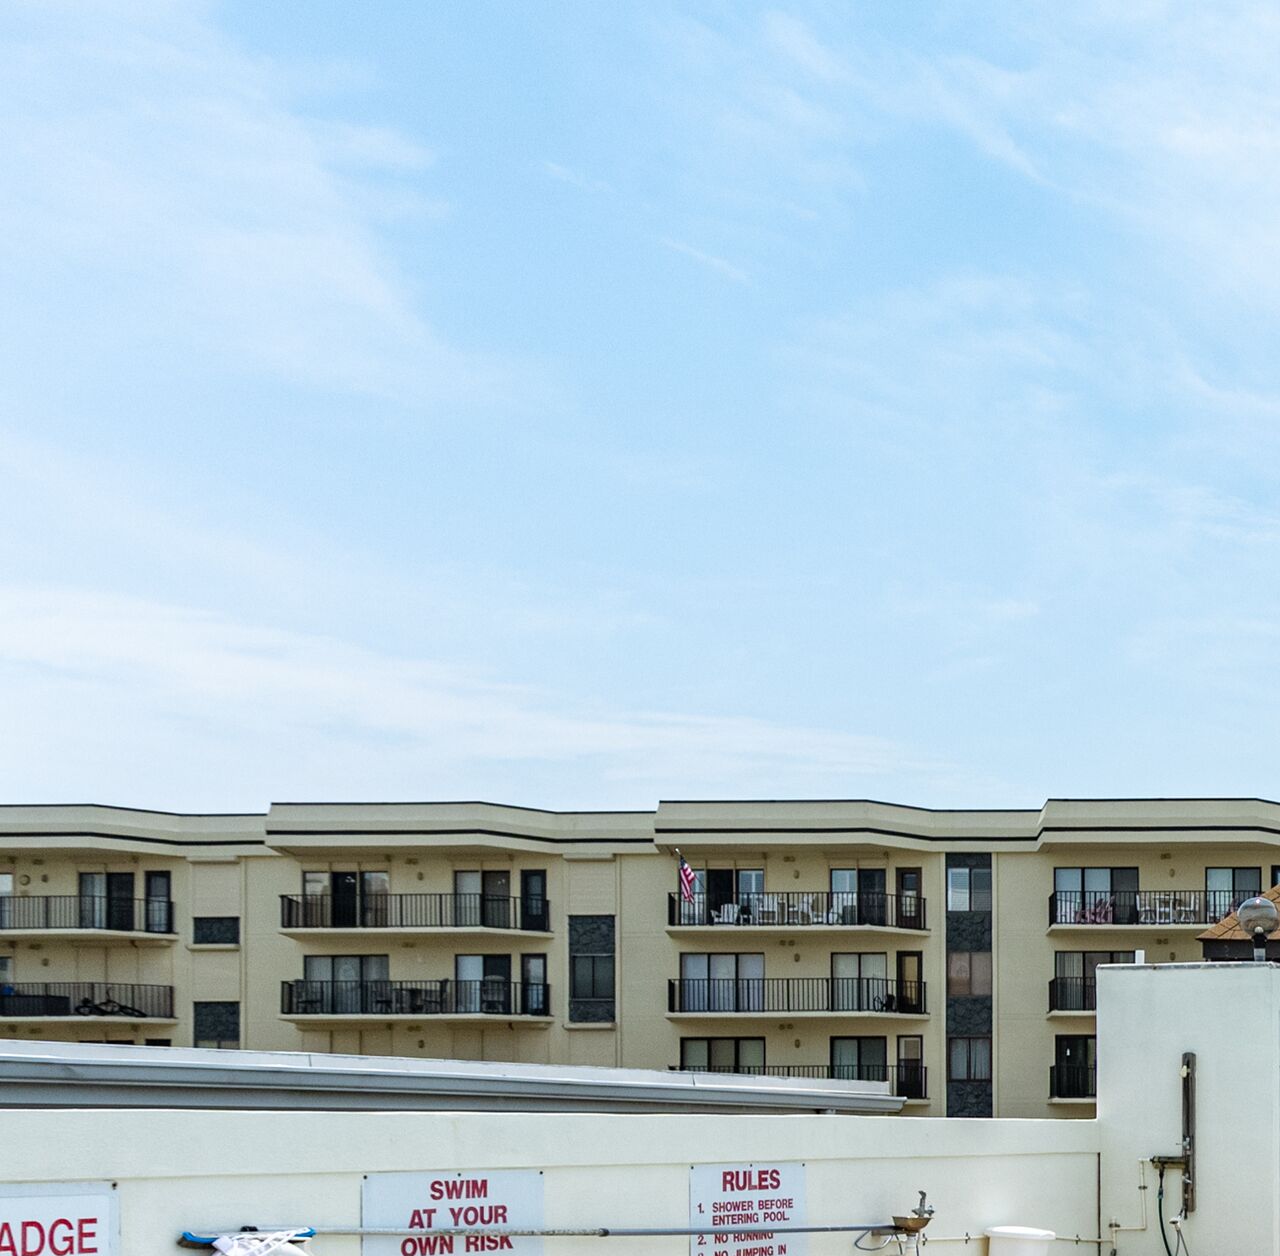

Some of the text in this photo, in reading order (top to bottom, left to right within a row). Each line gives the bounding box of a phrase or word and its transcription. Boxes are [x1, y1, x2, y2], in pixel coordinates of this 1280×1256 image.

[722, 1169, 781, 1192] RULES
[430, 1179, 488, 1200] SWIM
[697, 1198, 794, 1214] 1. SHOWER BEFORE
[408, 1204, 508, 1229] AT YOUR
[712, 1210, 791, 1227] ENTERING POOL.
[464, 1234, 514, 1252] RISK
[697, 1234, 707, 1246] 2.
[714, 1233, 729, 1245] NO
[778, 1243, 787, 1255] IN
